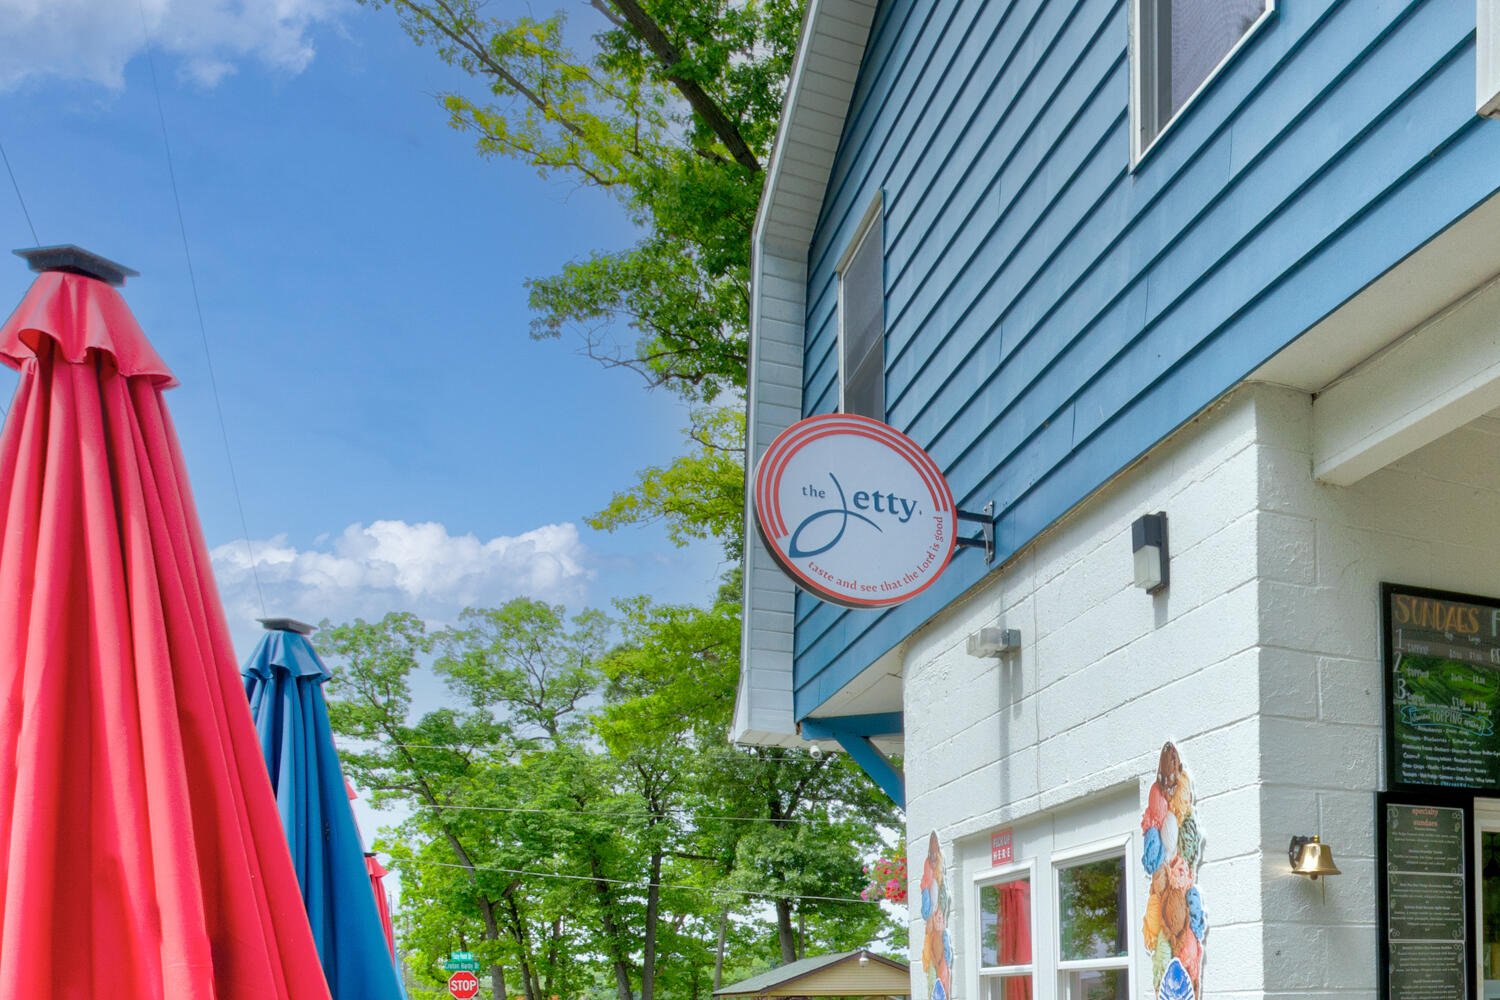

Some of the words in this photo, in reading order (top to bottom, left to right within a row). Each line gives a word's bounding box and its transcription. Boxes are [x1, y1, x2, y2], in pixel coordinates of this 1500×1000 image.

[802, 484, 826, 499] the
[933, 516, 944, 542] good
[930, 543, 940, 553] is
[917, 551, 936, 573] Lord
[808, 561, 834, 582] taste
[903, 570, 920, 584] the
[836, 580, 857, 591] and
[860, 583, 878, 592] see
[880, 579, 902, 592] that
[1394, 595, 1479, 634] SUNDAES
[450, 980, 477, 991] STOP
